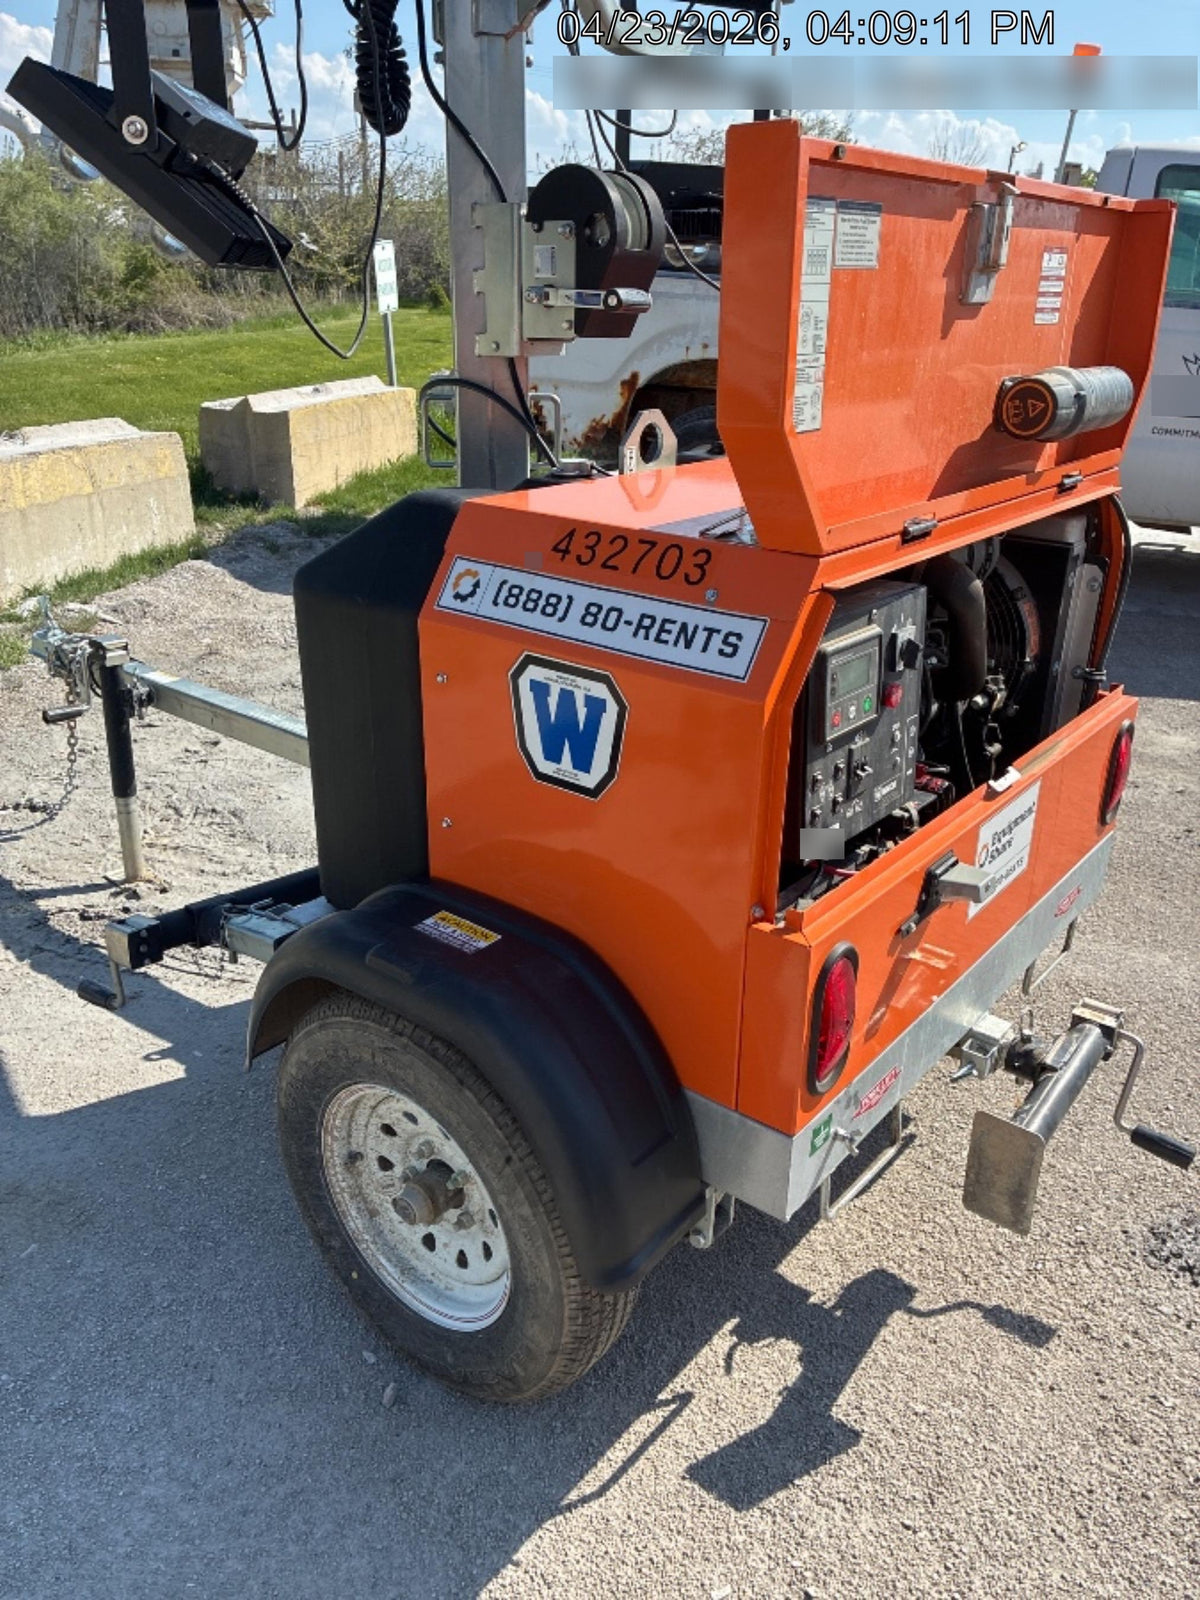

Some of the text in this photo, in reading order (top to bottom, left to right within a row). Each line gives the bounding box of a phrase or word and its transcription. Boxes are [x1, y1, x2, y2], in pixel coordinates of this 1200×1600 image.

[551, 527, 712, 586] 432703
[492, 579, 744, 659] (888) 80-RENTS
[529, 678, 607, 775] W
[987, 836, 1014, 865] Share
[990, 801, 1036, 847] Equipment
